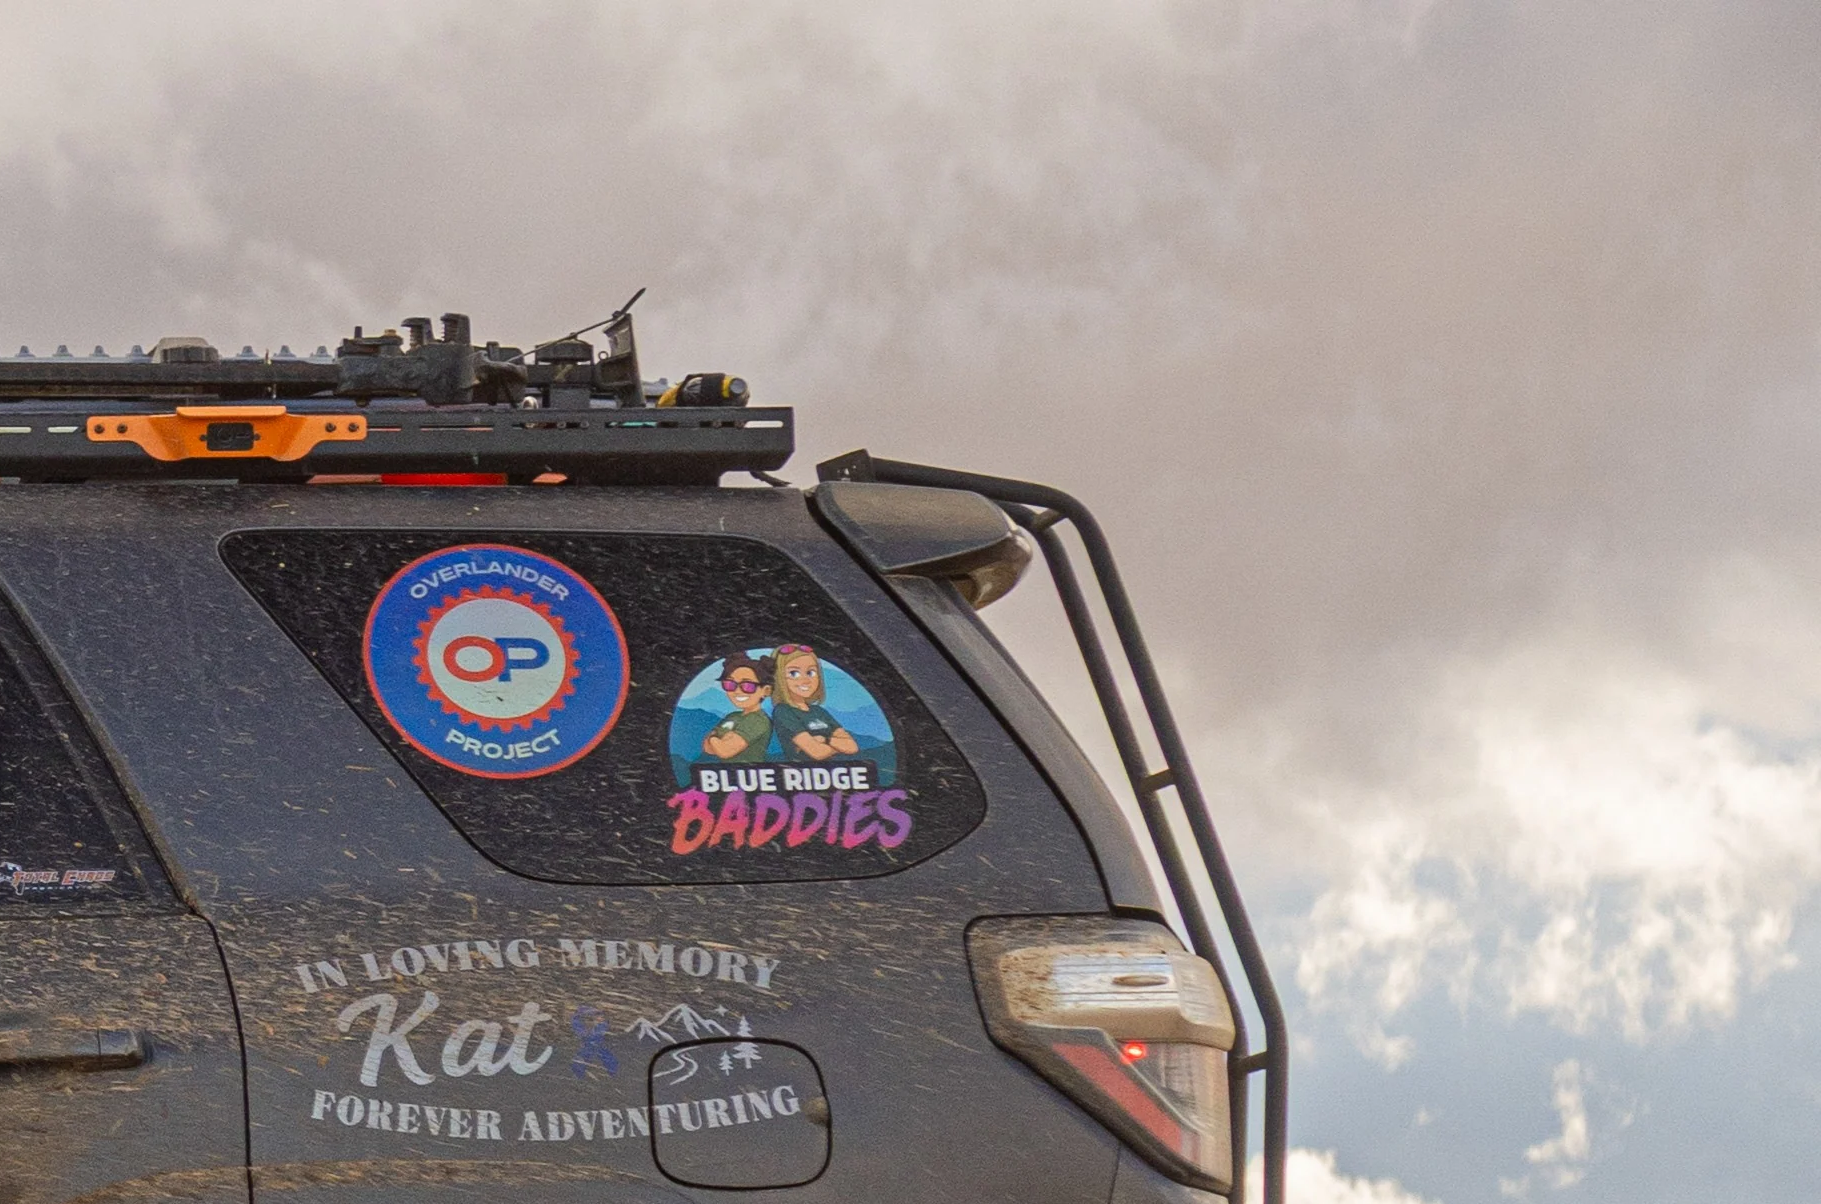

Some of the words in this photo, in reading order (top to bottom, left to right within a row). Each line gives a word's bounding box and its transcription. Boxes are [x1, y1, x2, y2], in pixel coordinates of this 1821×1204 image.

[410, 560, 570, 602] OVERLANDER
[443, 635, 550, 683] OP
[446, 728, 562, 760] PROJECT
[700, 767, 777, 793] BLUE
[784, 766, 870, 792] RIDGE
[666, 788, 913, 855] BADDIES
[294, 959, 351, 994] IN
[360, 938, 540, 983] LOVING
[558, 939, 782, 990] MEMORY
[337, 990, 555, 1088] Kat
[310, 1090, 503, 1142] FOREVER
[517, 1084, 801, 1143] ADVENTURING
